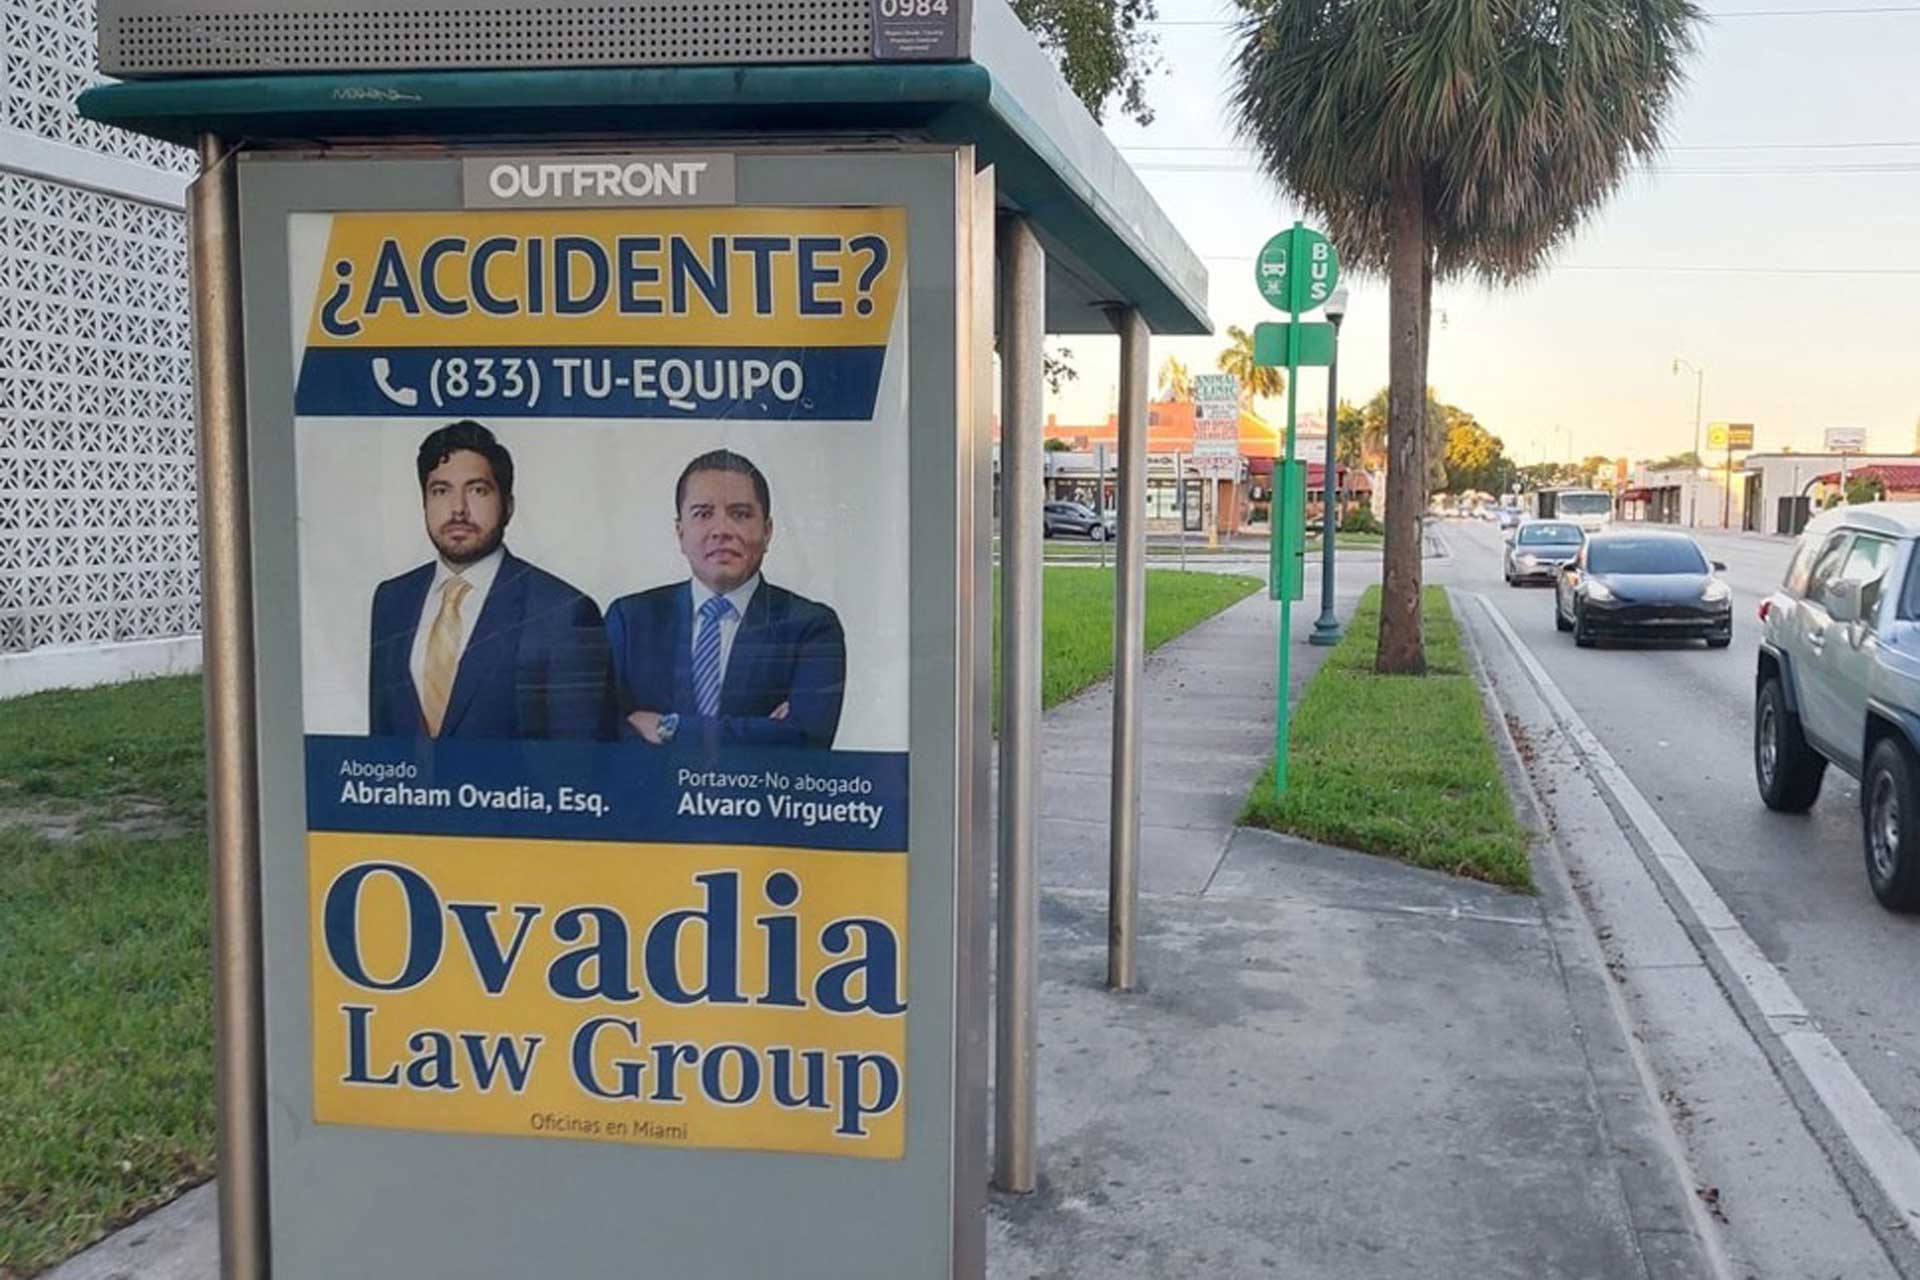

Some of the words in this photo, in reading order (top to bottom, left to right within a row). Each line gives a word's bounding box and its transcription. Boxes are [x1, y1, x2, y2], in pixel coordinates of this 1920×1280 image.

[881, 0, 949, 17] 0984
[489, 162, 707, 197] OUTFRONT
[319, 233, 890, 338] ¿ACCIDENTE?
[1311, 242, 1328, 301] BUS
[429, 357, 541, 408] (833)
[553, 358, 804, 410] TU-EQUIPO
[1197, 385, 1236, 395] CLINIC
[340, 760, 417, 781] Abogado
[678, 769, 790, 790] Portavoz-No
[795, 775, 872, 797] abogado
[341, 781, 450, 807] Abraham
[458, 784, 552, 815] Ovadia,
[558, 787, 610, 818] Esq.
[677, 792, 761, 817] Alvaro
[767, 794, 883, 830] Virguetty
[323, 861, 907, 1014] Ovadia
[340, 1005, 541, 1093] Law
[571, 1017, 900, 1139] Group
[530, 1112, 601, 1134] Oficinas
[606, 1121, 626, 1136] en
[633, 1120, 688, 1140] Miami
